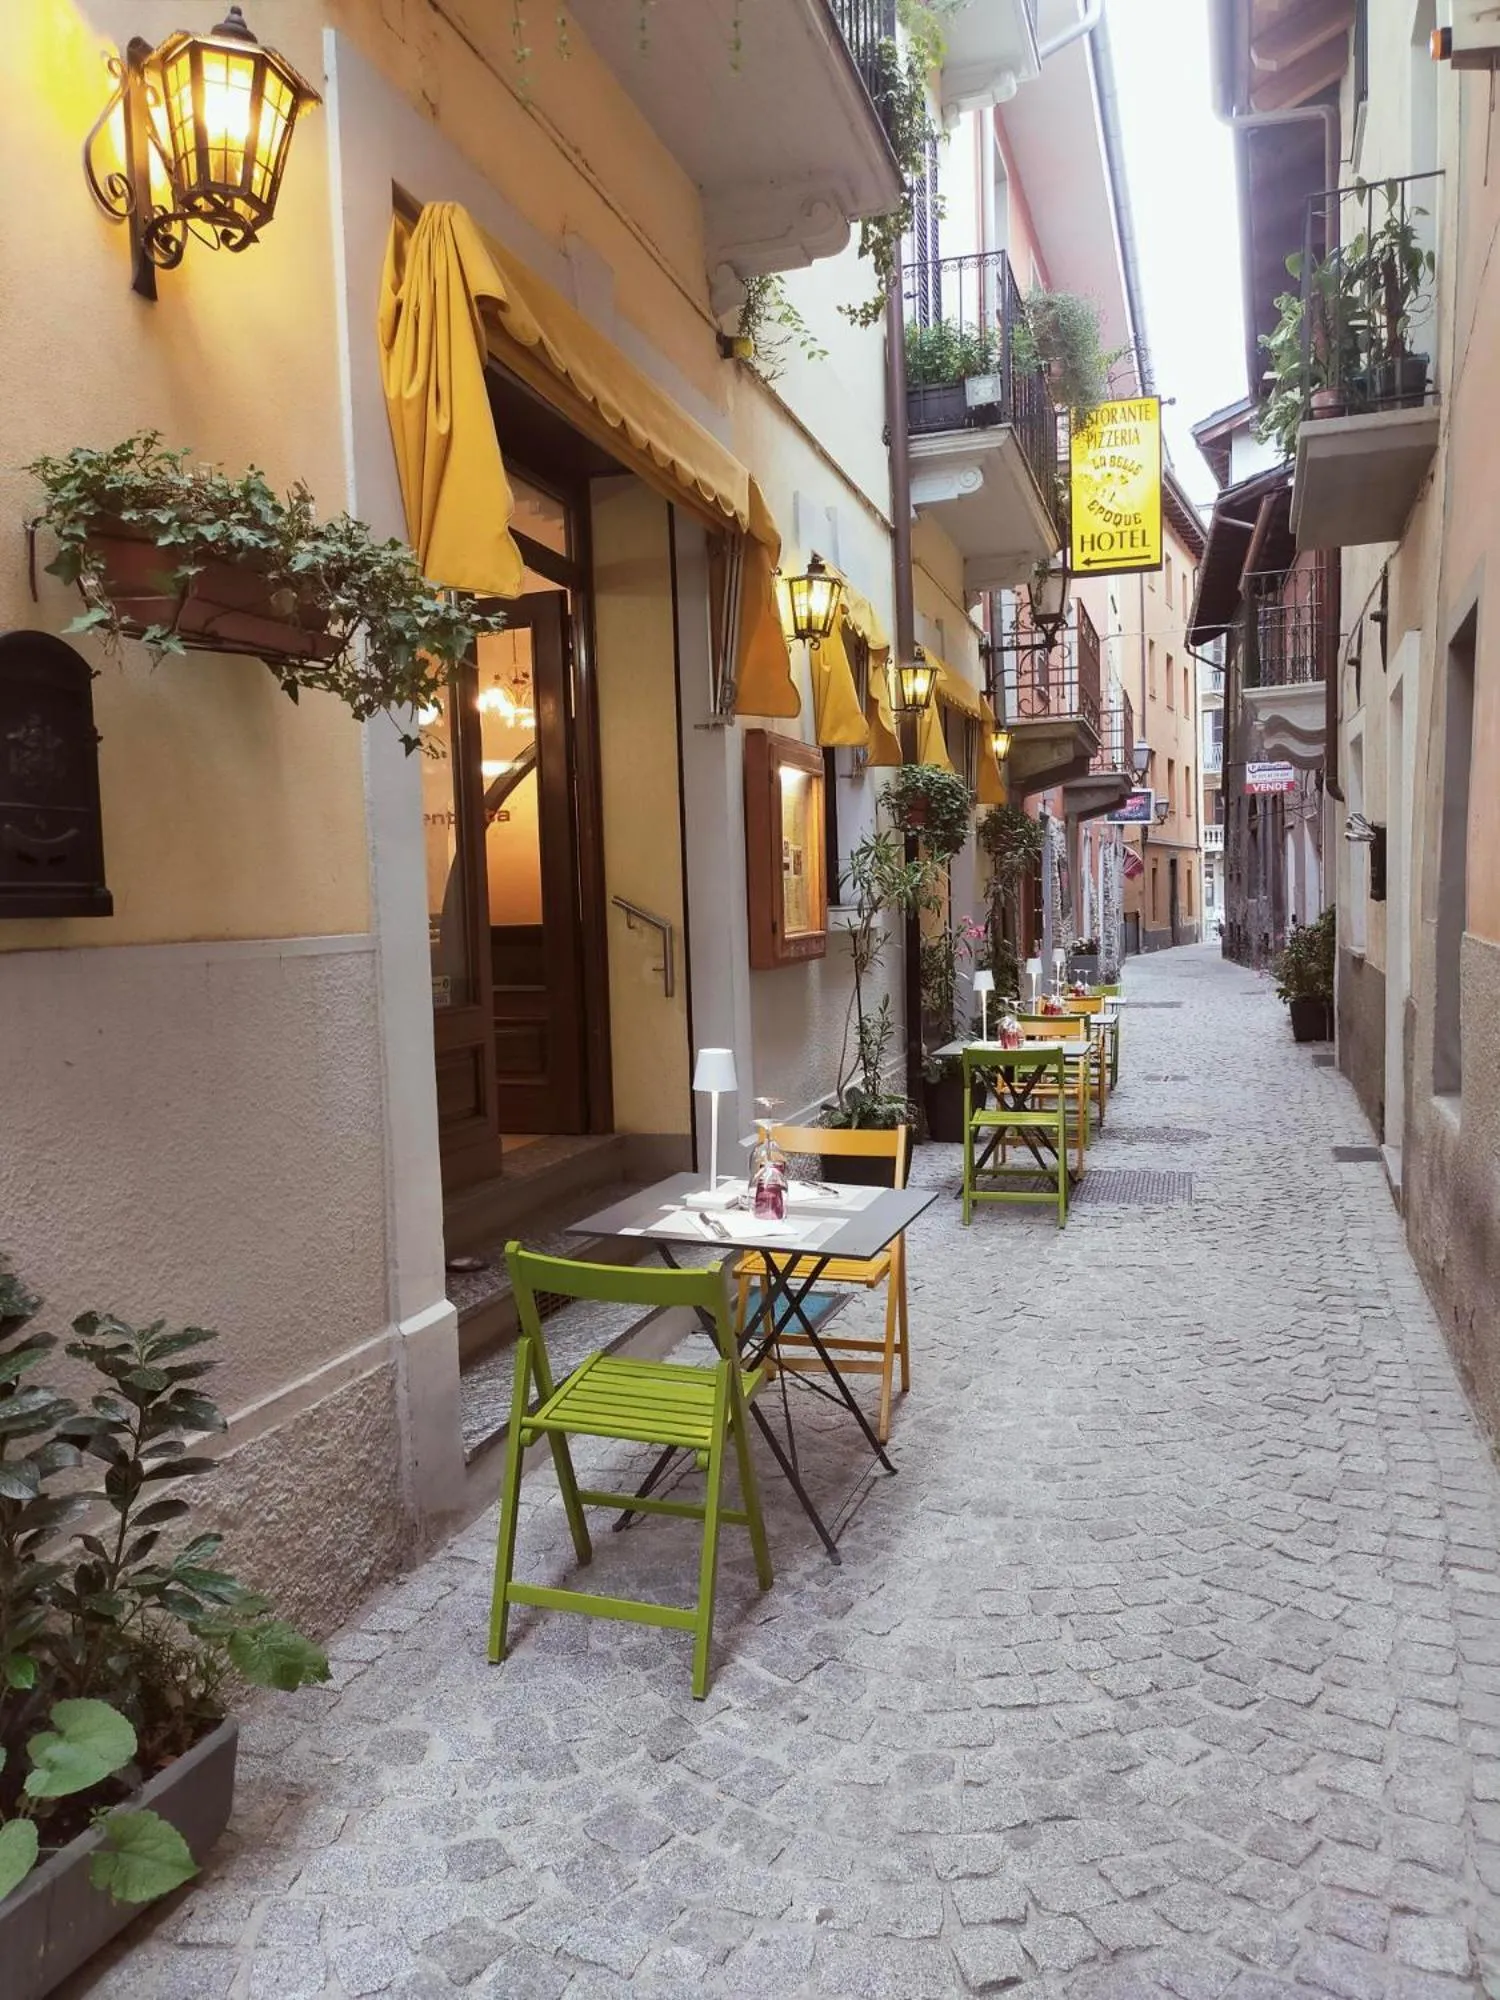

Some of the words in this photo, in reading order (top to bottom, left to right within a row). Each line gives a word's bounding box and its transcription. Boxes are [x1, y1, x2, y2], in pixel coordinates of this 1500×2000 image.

[1081, 403, 1151, 427] STORANTE
[1087, 428, 1141, 449] PIZZERIA
[1109, 455, 1143, 476] BELLE
[1087, 499, 1142, 528] EPOQUE
[1080, 528, 1151, 553] HOTEL
[1252, 782, 1288, 792] VENDE
